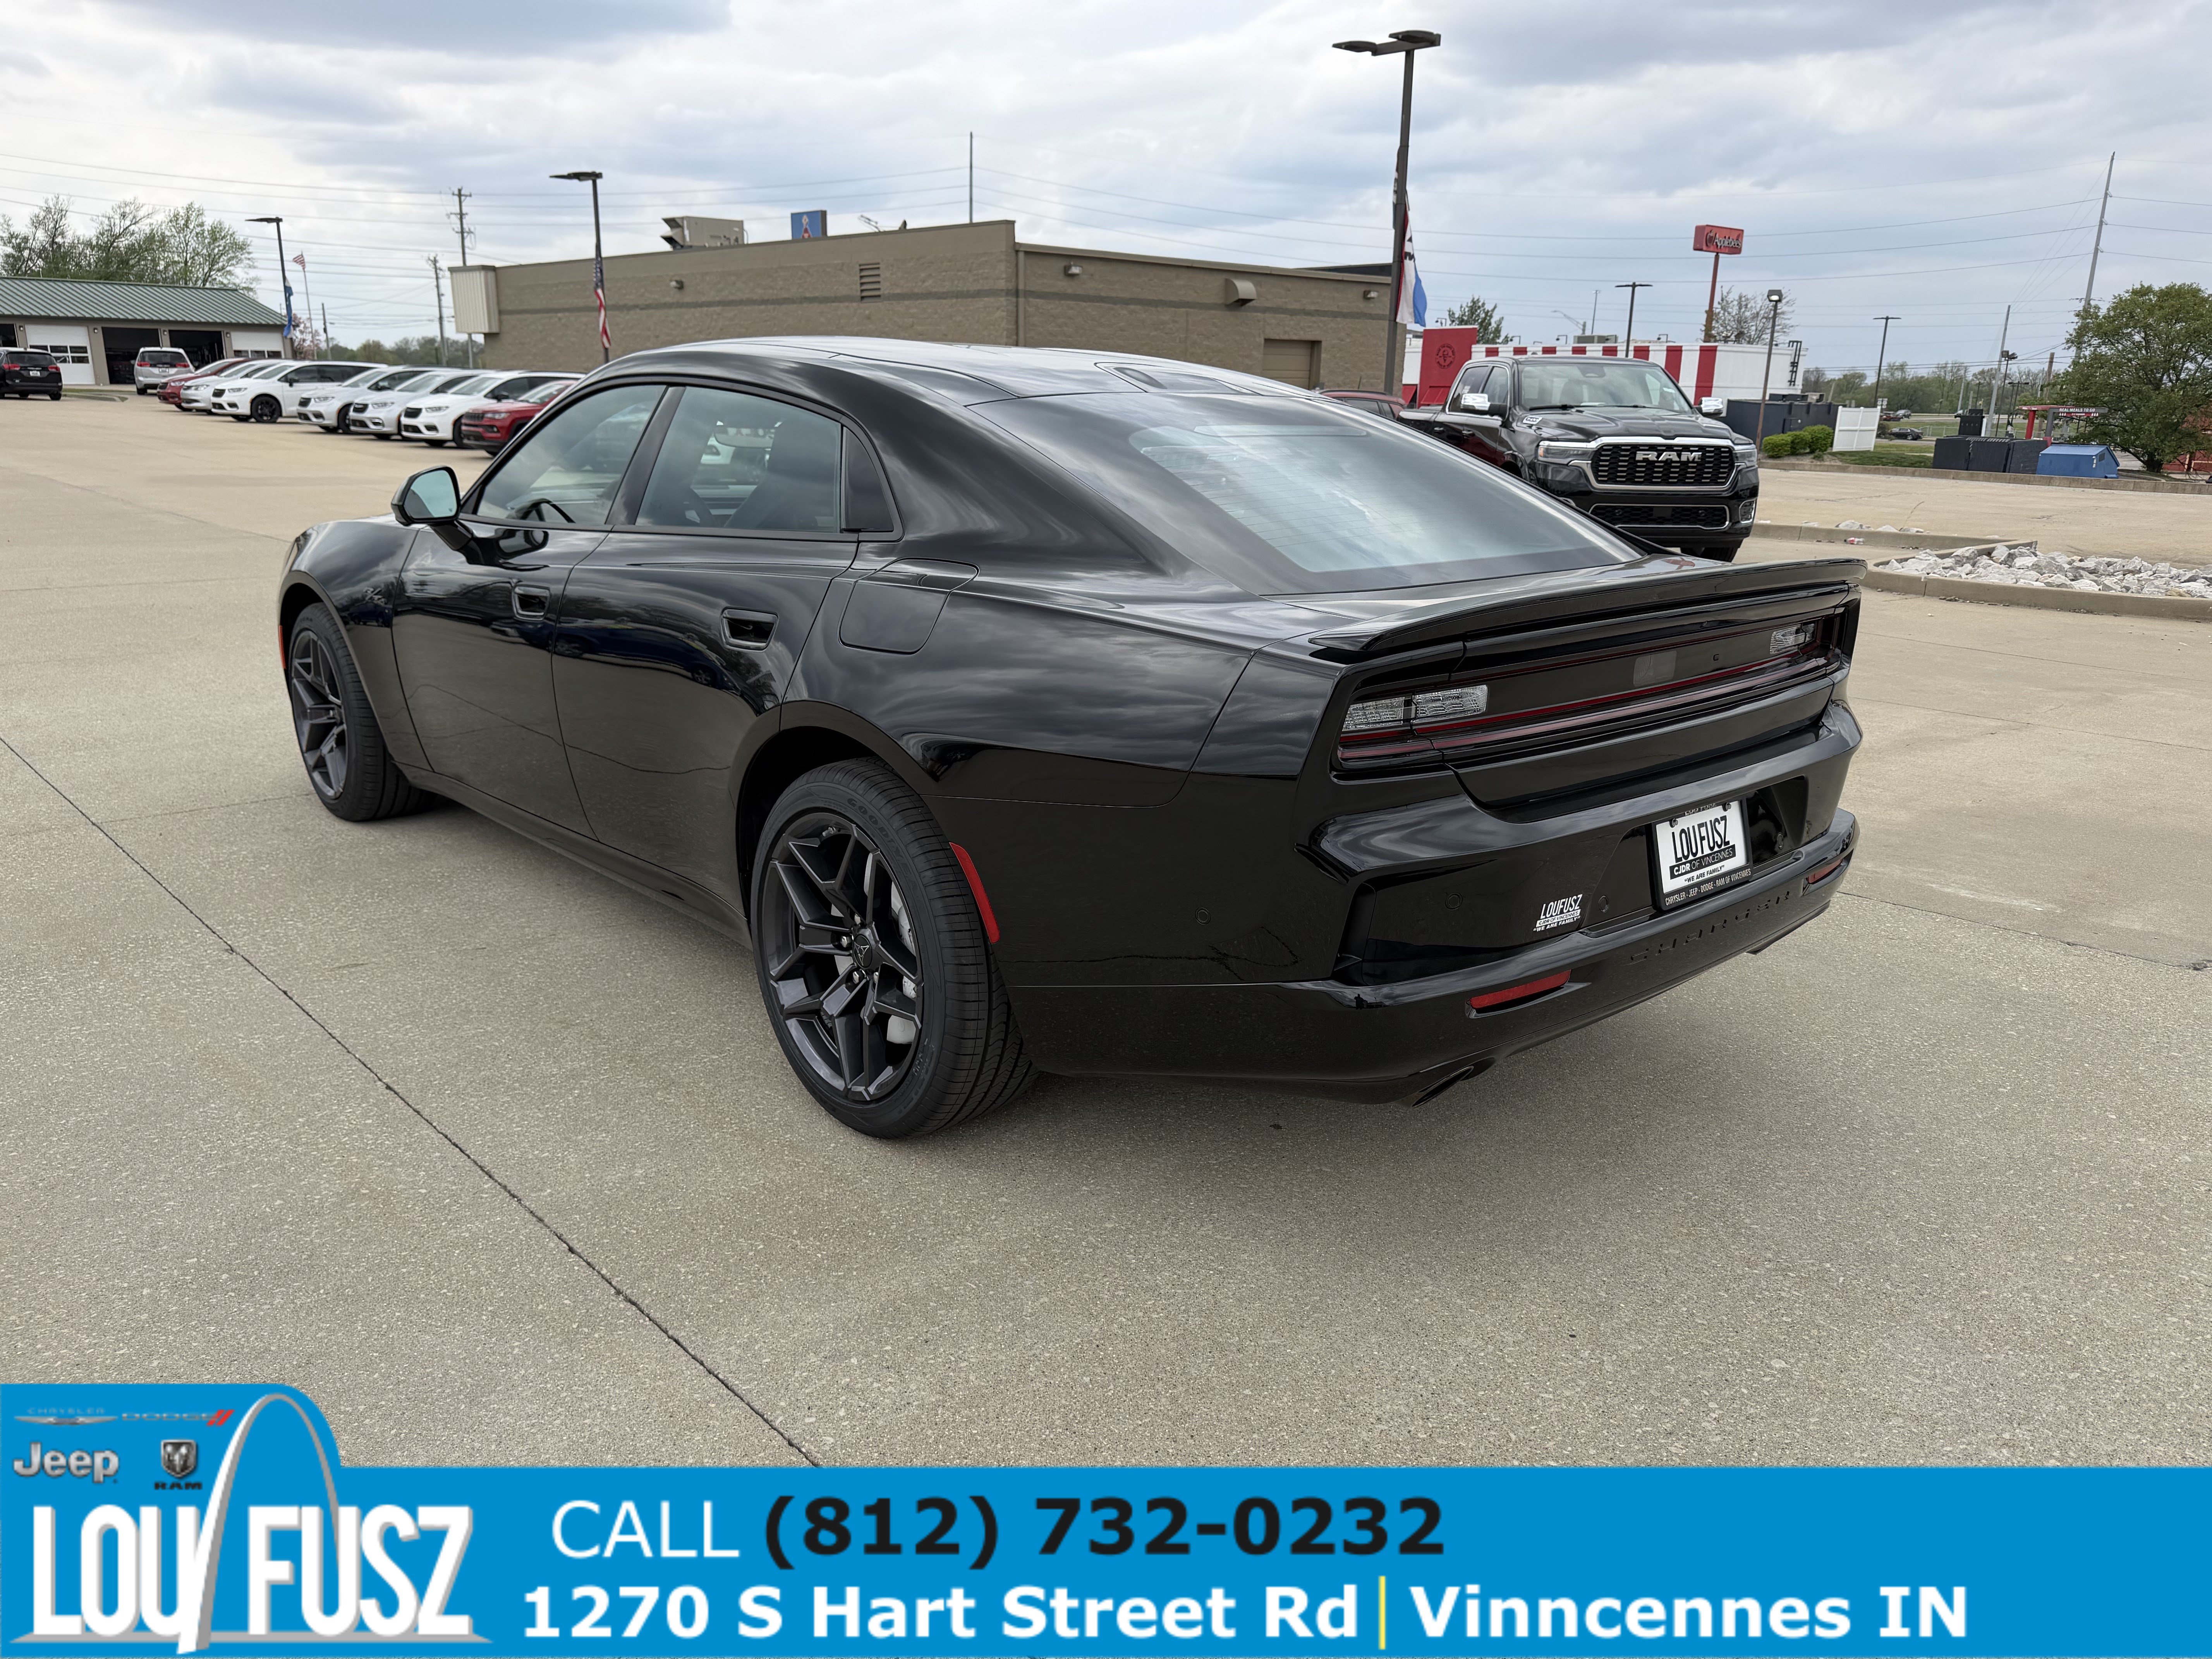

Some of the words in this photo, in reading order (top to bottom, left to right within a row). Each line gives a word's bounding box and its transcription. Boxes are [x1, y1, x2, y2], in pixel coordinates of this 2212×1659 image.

[1635, 451, 1702, 462] RAM
[1671, 825, 1698, 864] LOU
[1697, 815, 1730, 855] FUSZ
[1674, 863, 1690, 875] CJDR
[1692, 859, 1700, 869] OF
[1701, 848, 1733, 864] VINCENNES
[1666, 892, 1686, 905] CHRYSLER
[1688, 887, 1698, 897] JEEP
[1700, 881, 1714, 892] DODGE
[1716, 878, 1725, 887] RAM
[1731, 869, 1751, 881] VINCENNES
